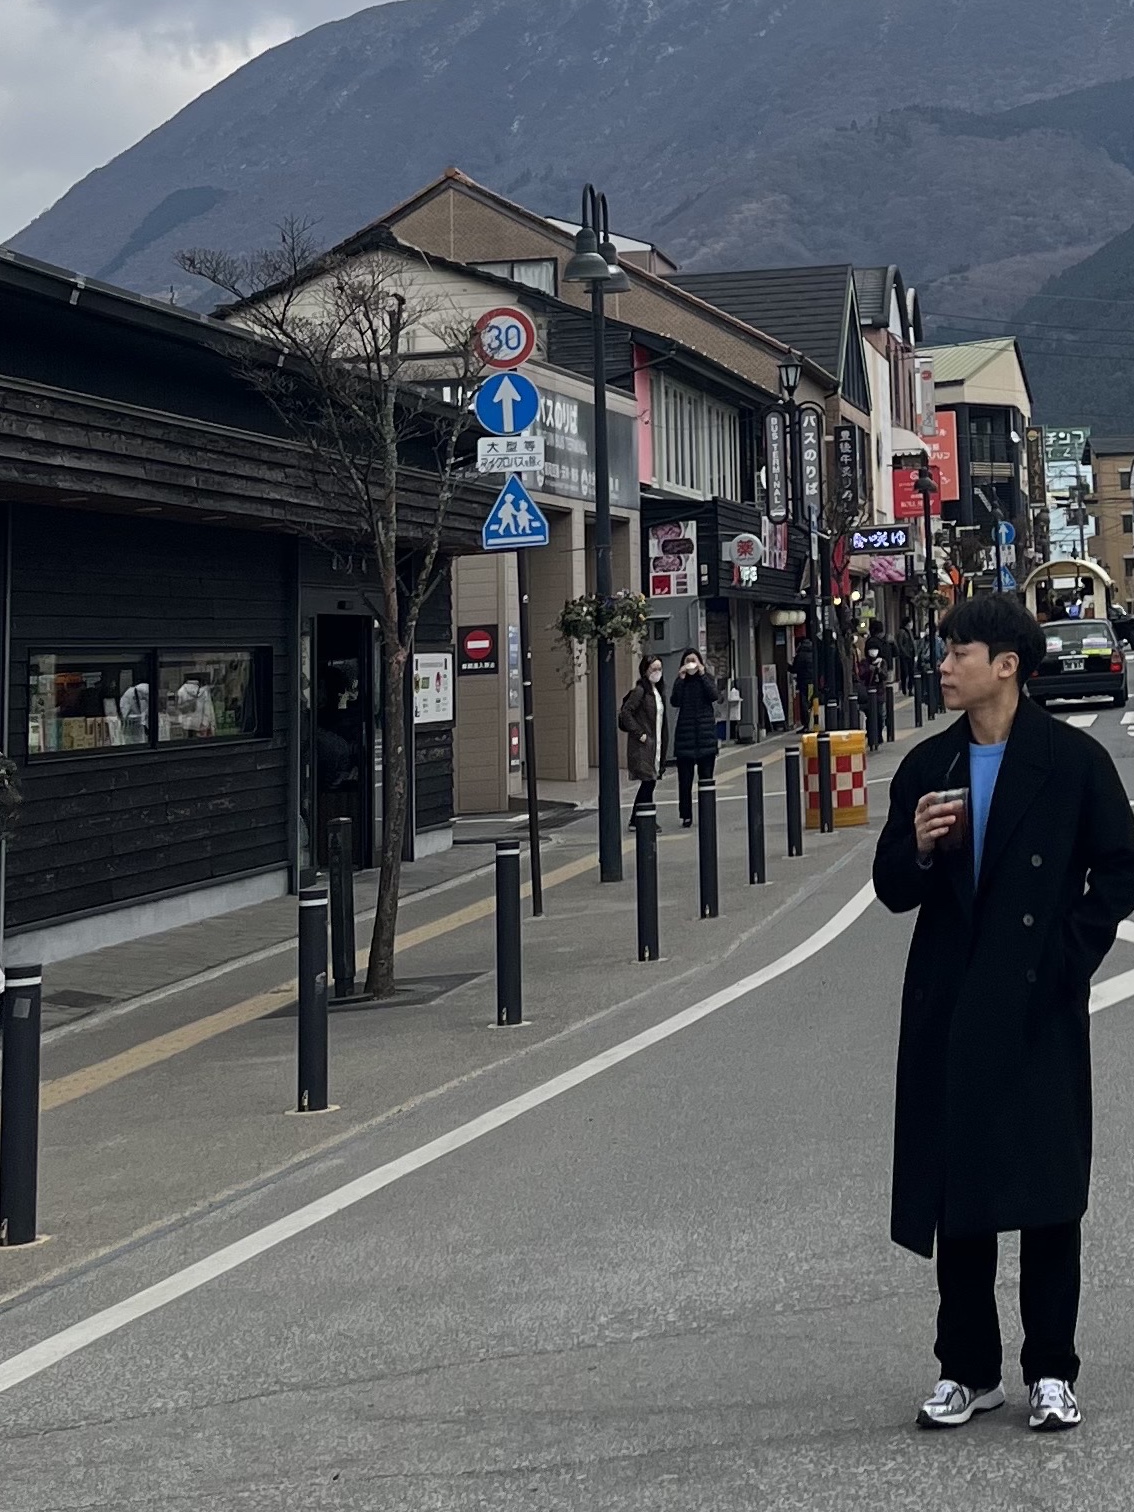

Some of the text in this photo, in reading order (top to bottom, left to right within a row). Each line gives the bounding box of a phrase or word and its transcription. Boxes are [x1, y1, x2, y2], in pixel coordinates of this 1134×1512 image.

[487, 324, 522, 351] 30
[486, 440, 536, 454] 大型等
[770, 417, 781, 504] BUS TERMINAL
[802, 415, 819, 496] バスのりば
